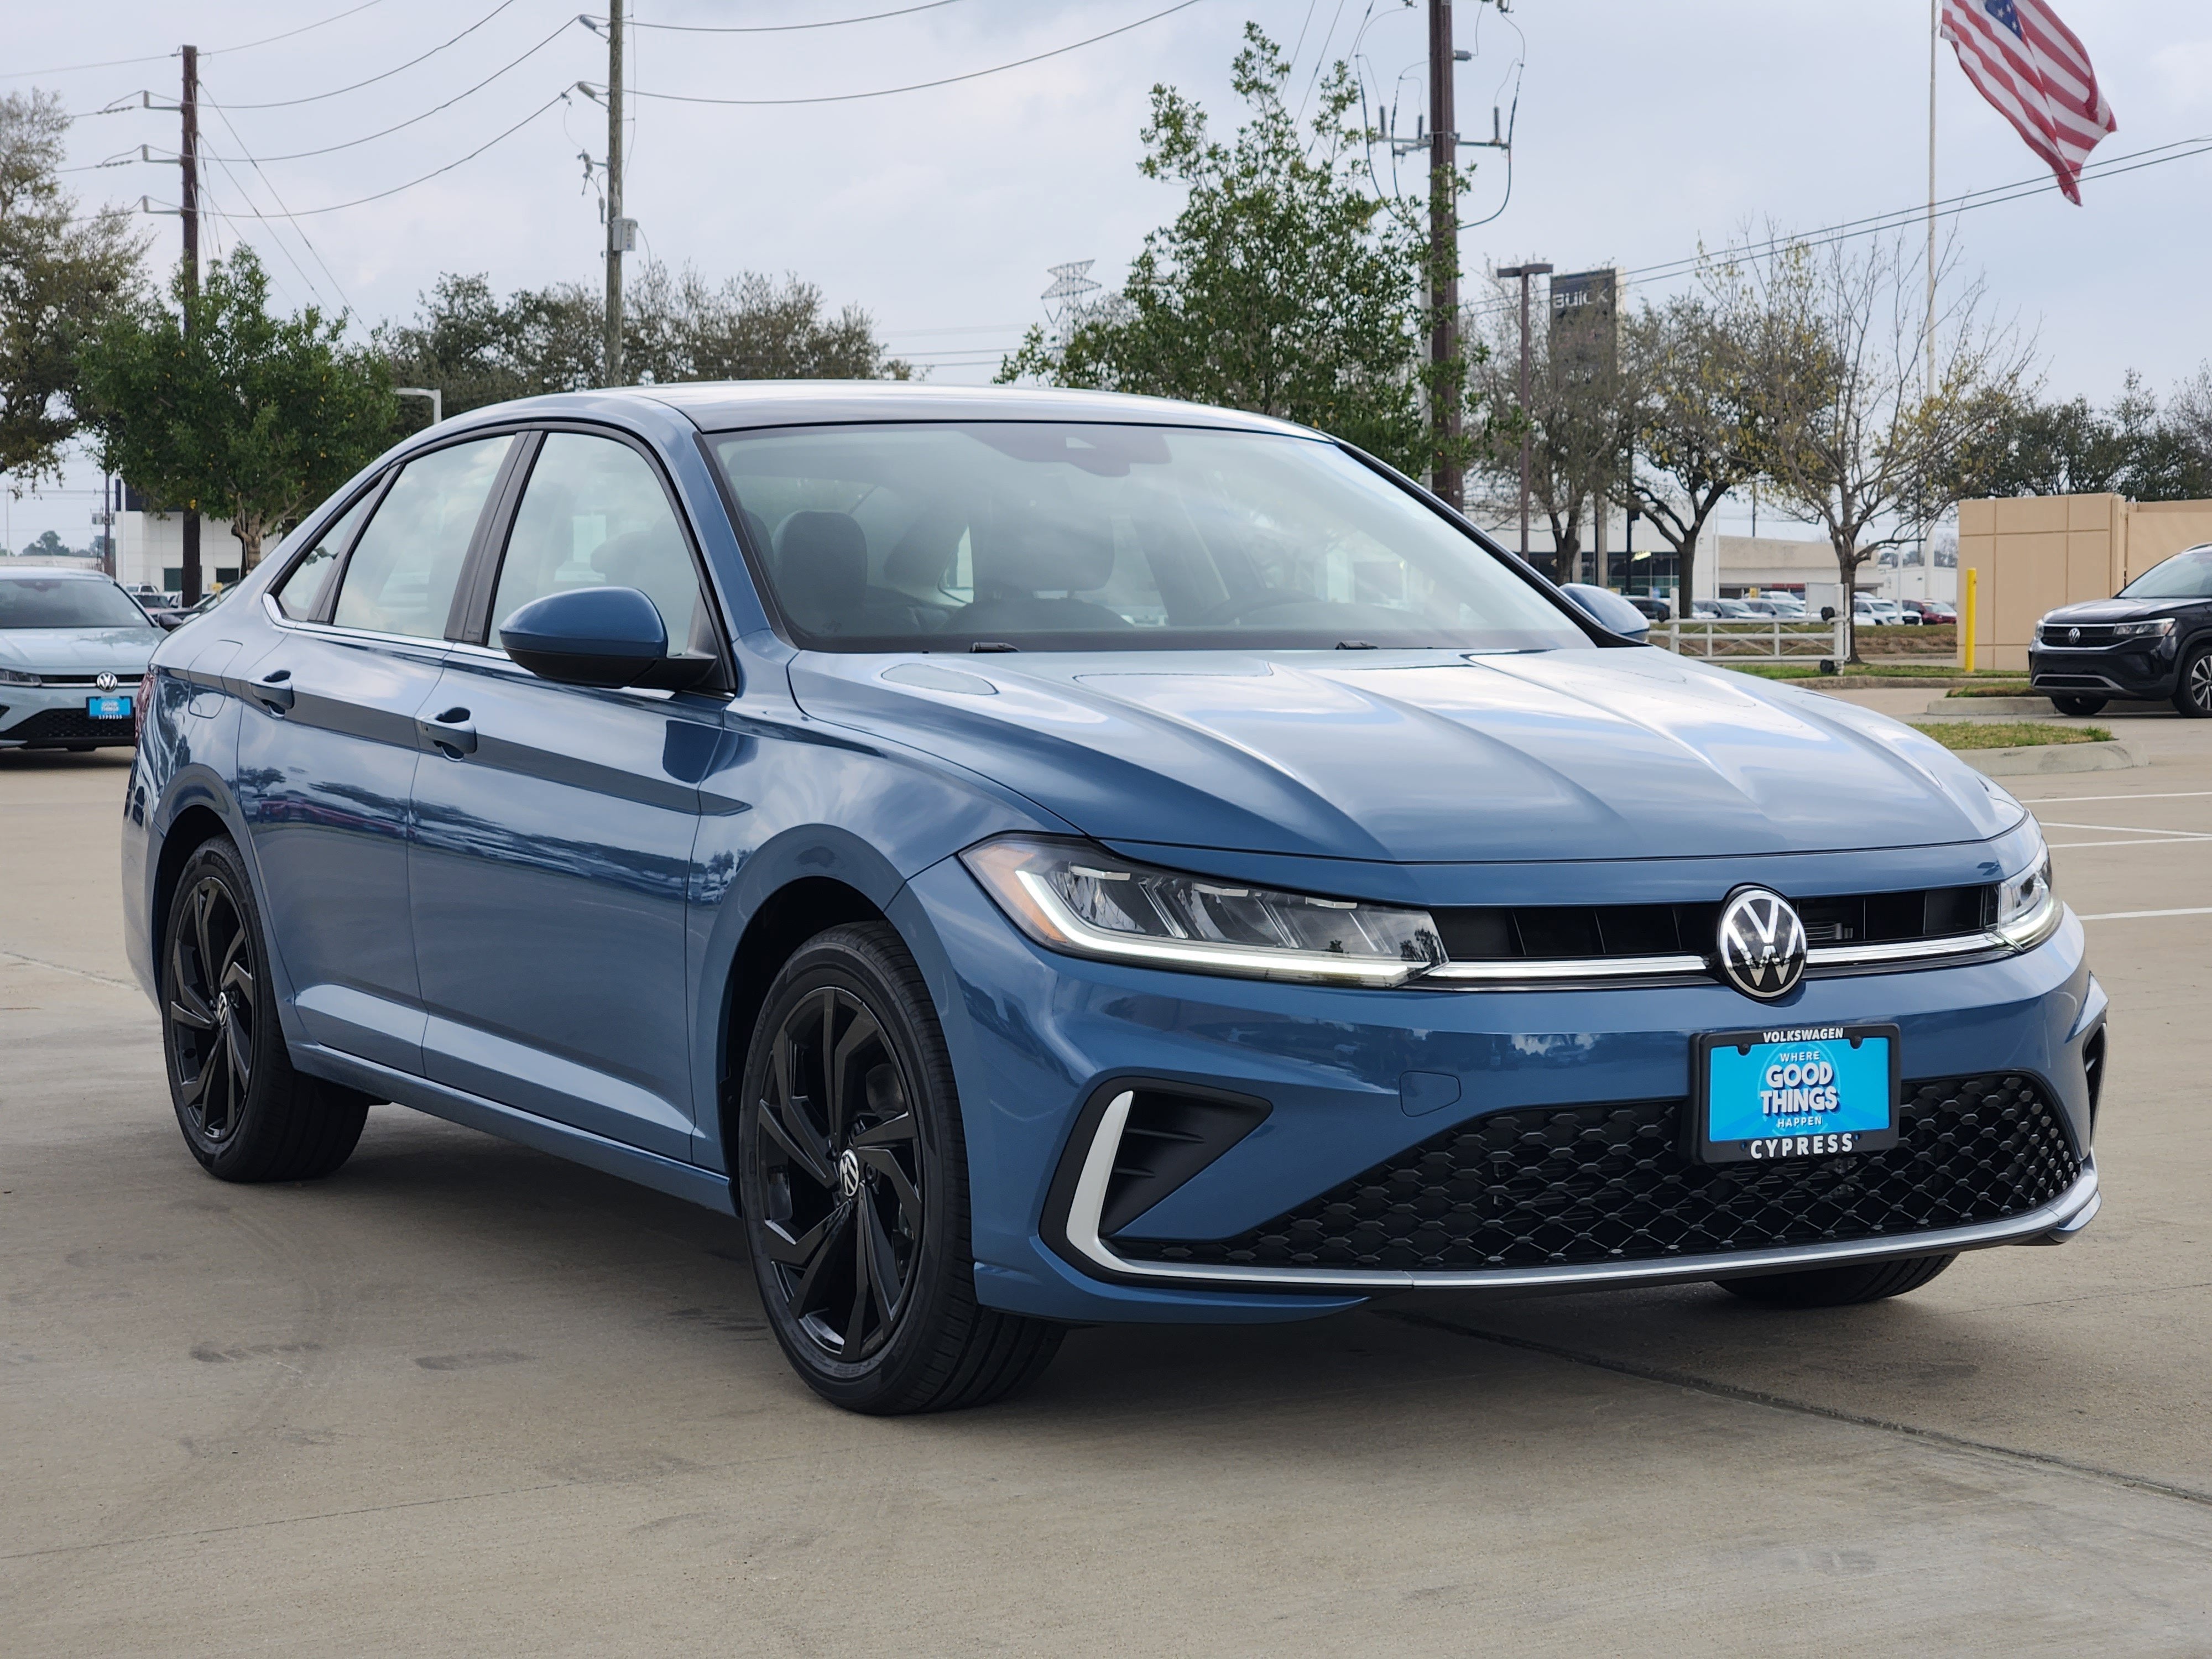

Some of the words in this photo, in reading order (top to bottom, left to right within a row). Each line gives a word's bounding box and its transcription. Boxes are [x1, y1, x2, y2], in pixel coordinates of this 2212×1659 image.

[97, 672, 117, 691] VW
[1721, 891, 1805, 995] VW
[1763, 1027, 1844, 1043] VOLKSWAGEN
[1780, 1051, 1820, 1062] WHERE
[1766, 1061, 1834, 1088] GOOD
[1760, 1086, 1839, 1115] THINGS
[1777, 1116, 1823, 1128] HAPPEN
[1750, 1133, 1854, 1160] CYPRESS
[840, 1149, 859, 1196] VW
